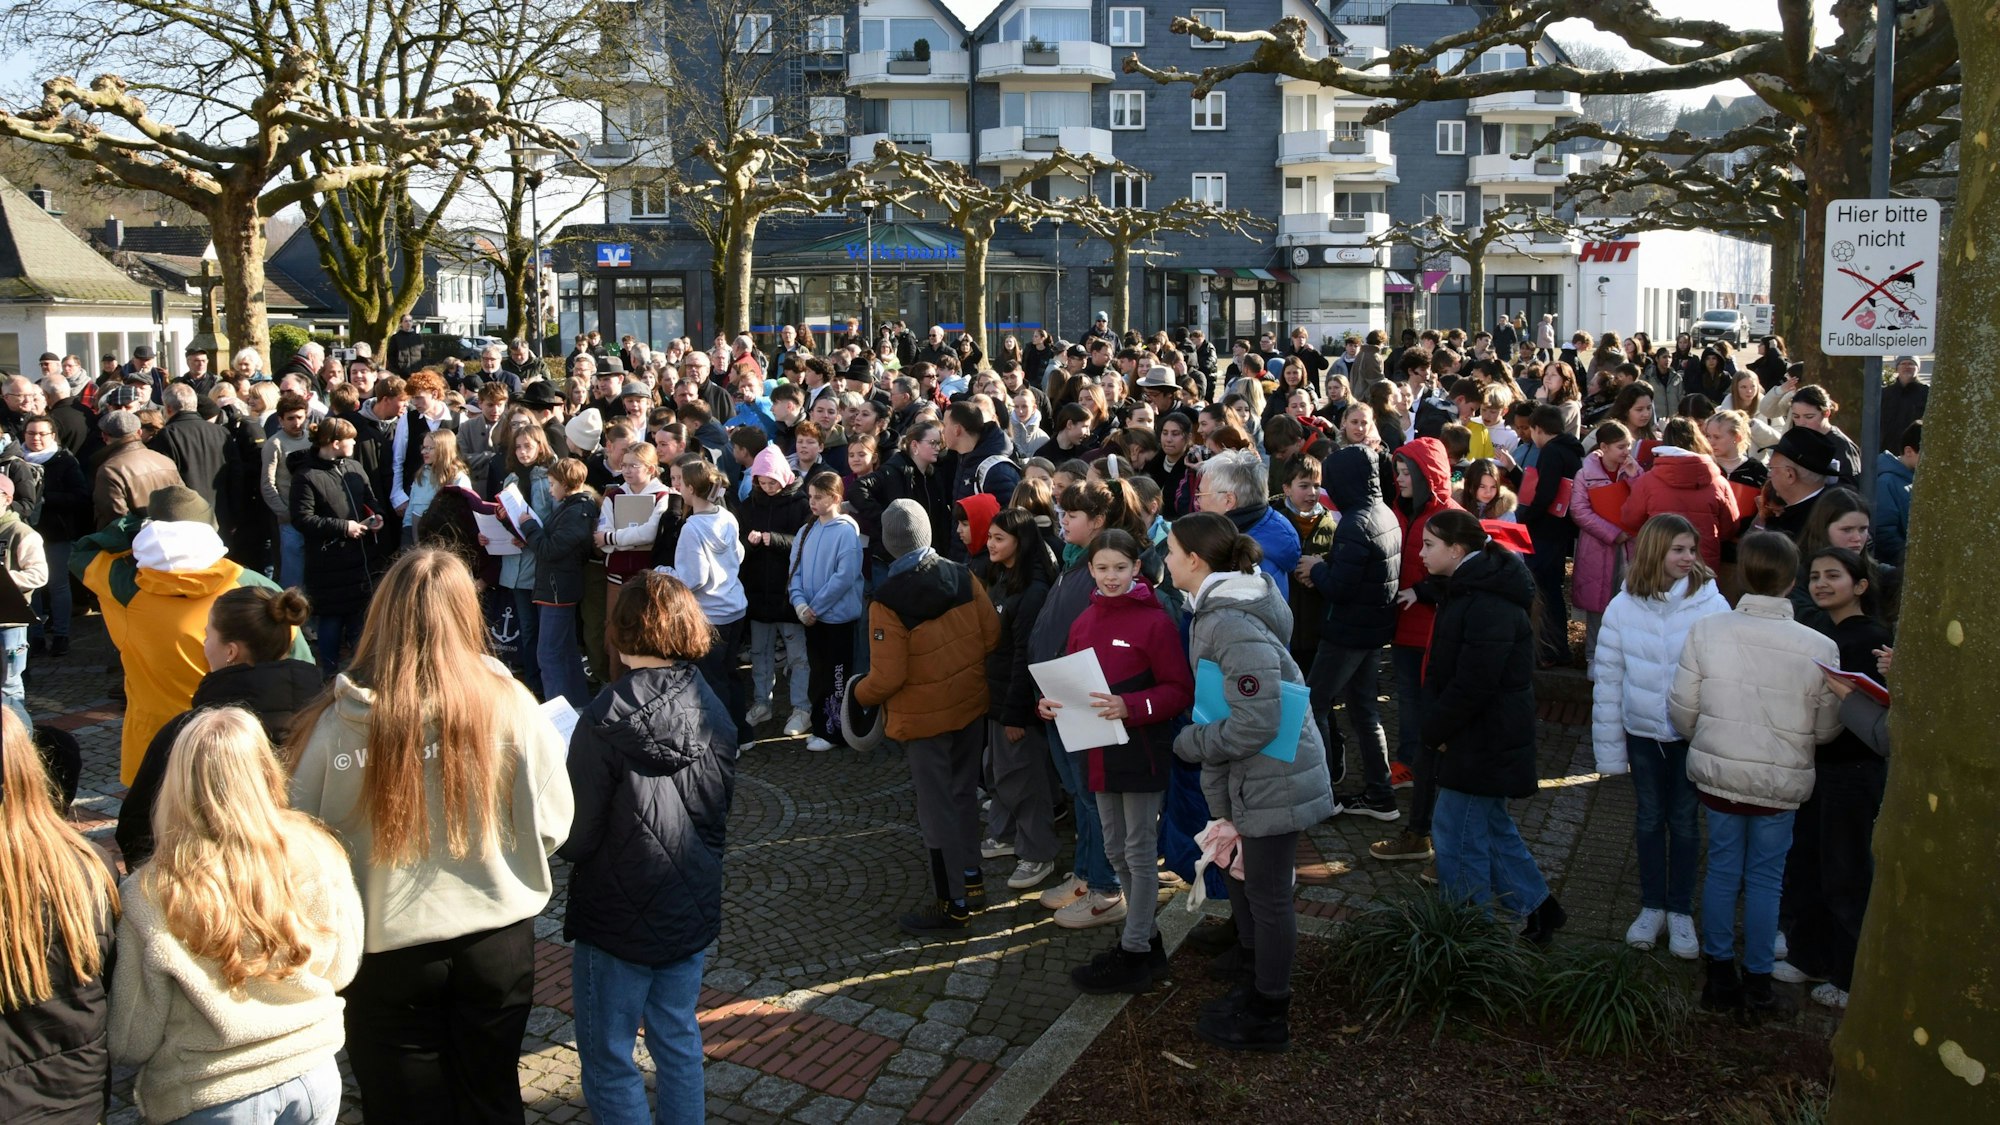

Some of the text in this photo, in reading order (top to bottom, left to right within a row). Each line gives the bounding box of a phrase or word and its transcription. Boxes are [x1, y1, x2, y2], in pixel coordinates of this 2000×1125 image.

[1838, 205, 1927, 223] Hier bitte
[1858, 230, 1905, 247] nicht
[1579, 241, 1640, 262] HIT
[1828, 332, 1927, 349] Fußballspielen
